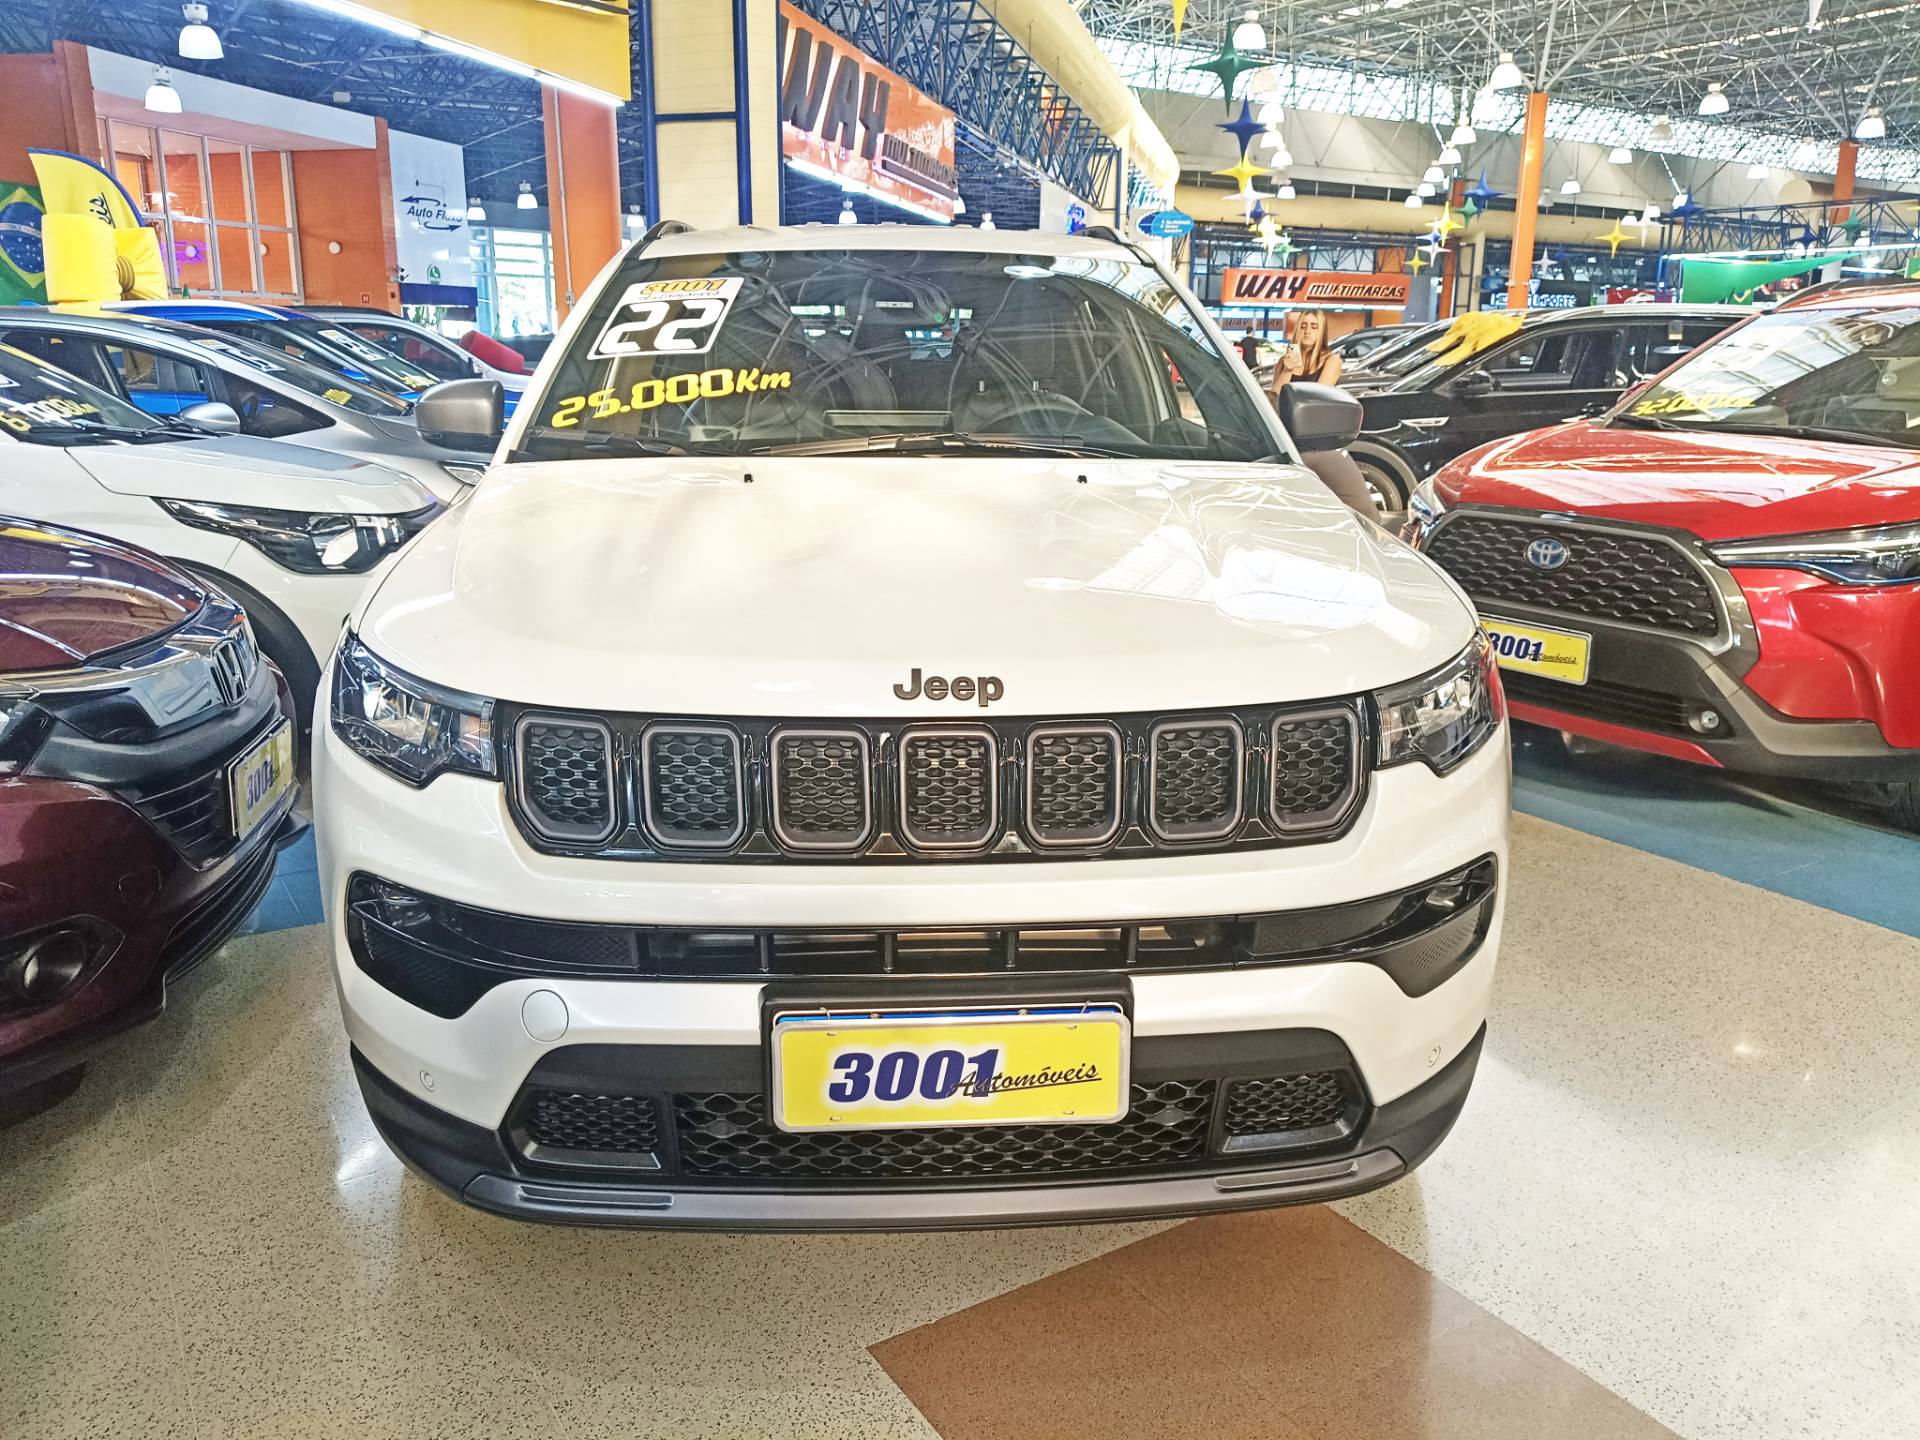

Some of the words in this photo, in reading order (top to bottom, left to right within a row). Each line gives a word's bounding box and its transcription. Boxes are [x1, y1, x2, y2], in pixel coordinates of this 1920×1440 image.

[407, 205, 433, 218] Auto
[639, 279, 728, 296] 3001
[1235, 274, 1307, 299] WAY
[1309, 283, 1405, 298] MULTIMARCAS
[599, 299, 725, 351] 22
[1488, 632, 1543, 662] 3001
[893, 668, 1004, 707] Jeep
[829, 1049, 999, 1103] 3001
[947, 1062, 1099, 1098] Automóveis
